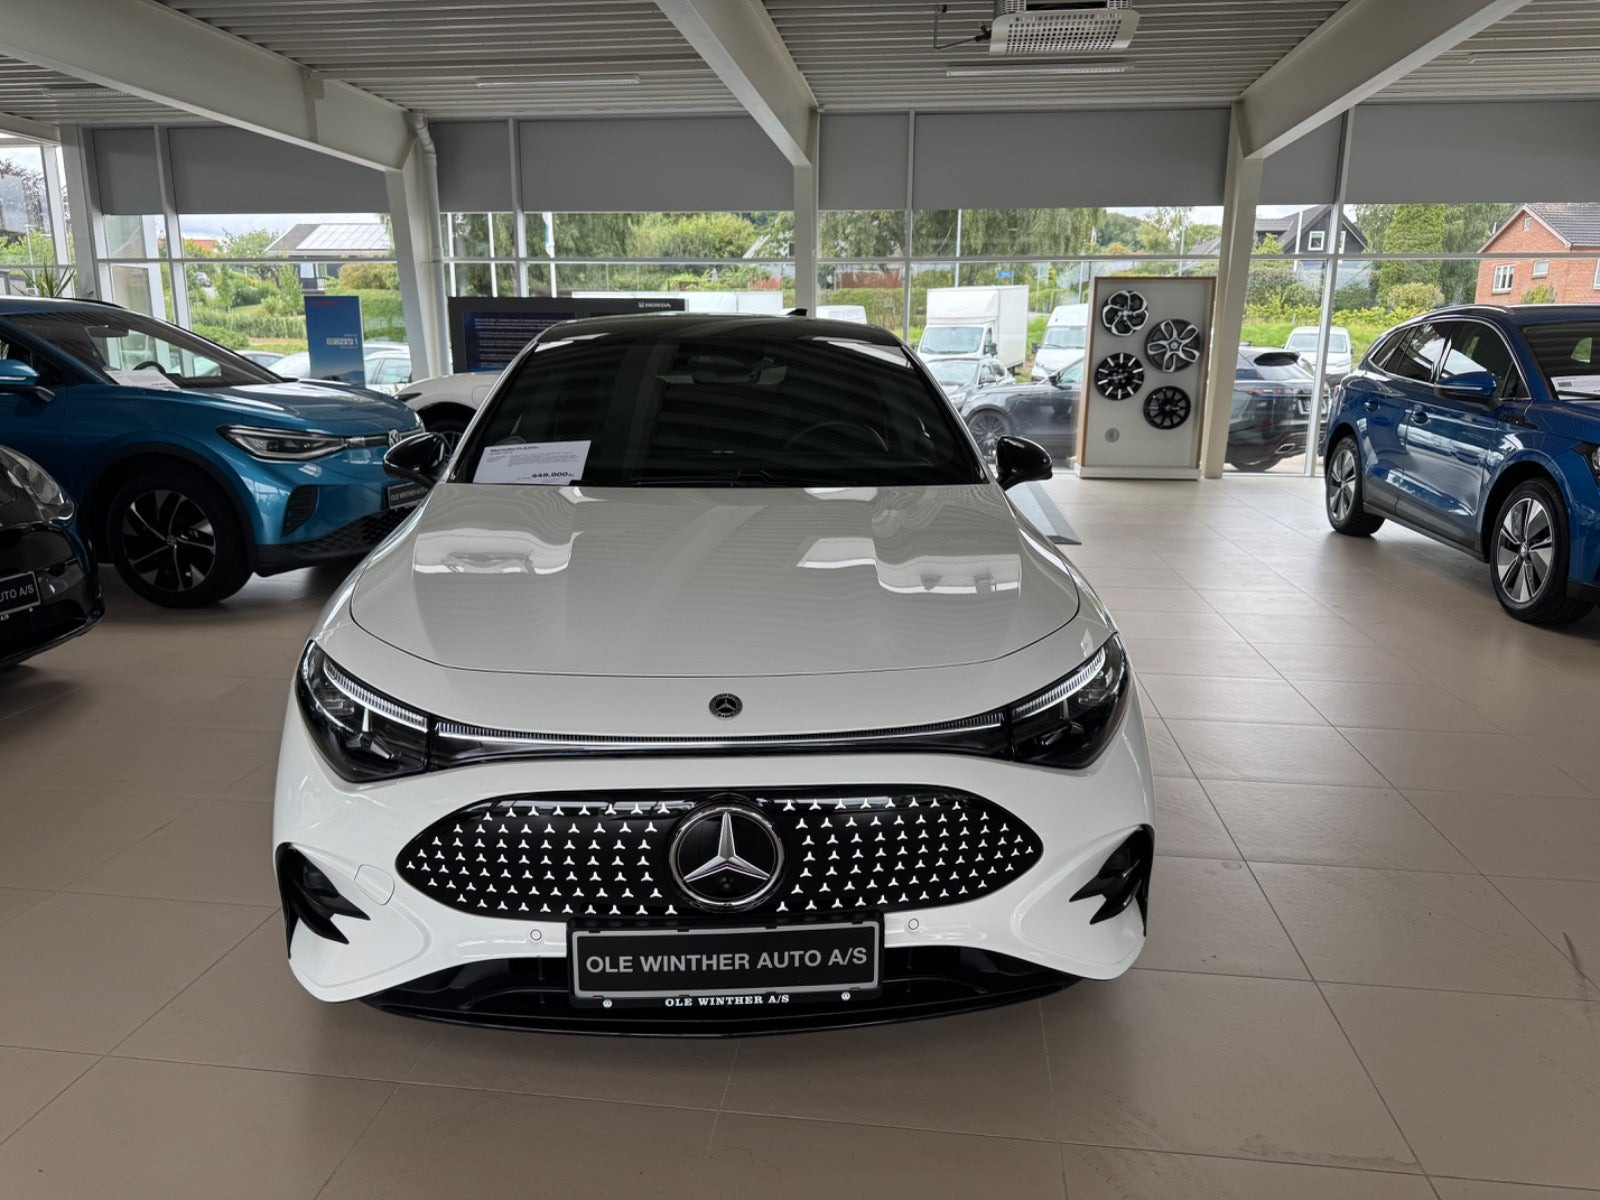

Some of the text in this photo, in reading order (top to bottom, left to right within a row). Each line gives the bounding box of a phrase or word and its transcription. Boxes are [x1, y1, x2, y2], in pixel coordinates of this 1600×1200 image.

[20, 584, 34, 596] A/S
[586, 947, 867, 973] OLE WINTHER AUTO A/S
[664, 993, 790, 1007] OLE WINTHER A/S
